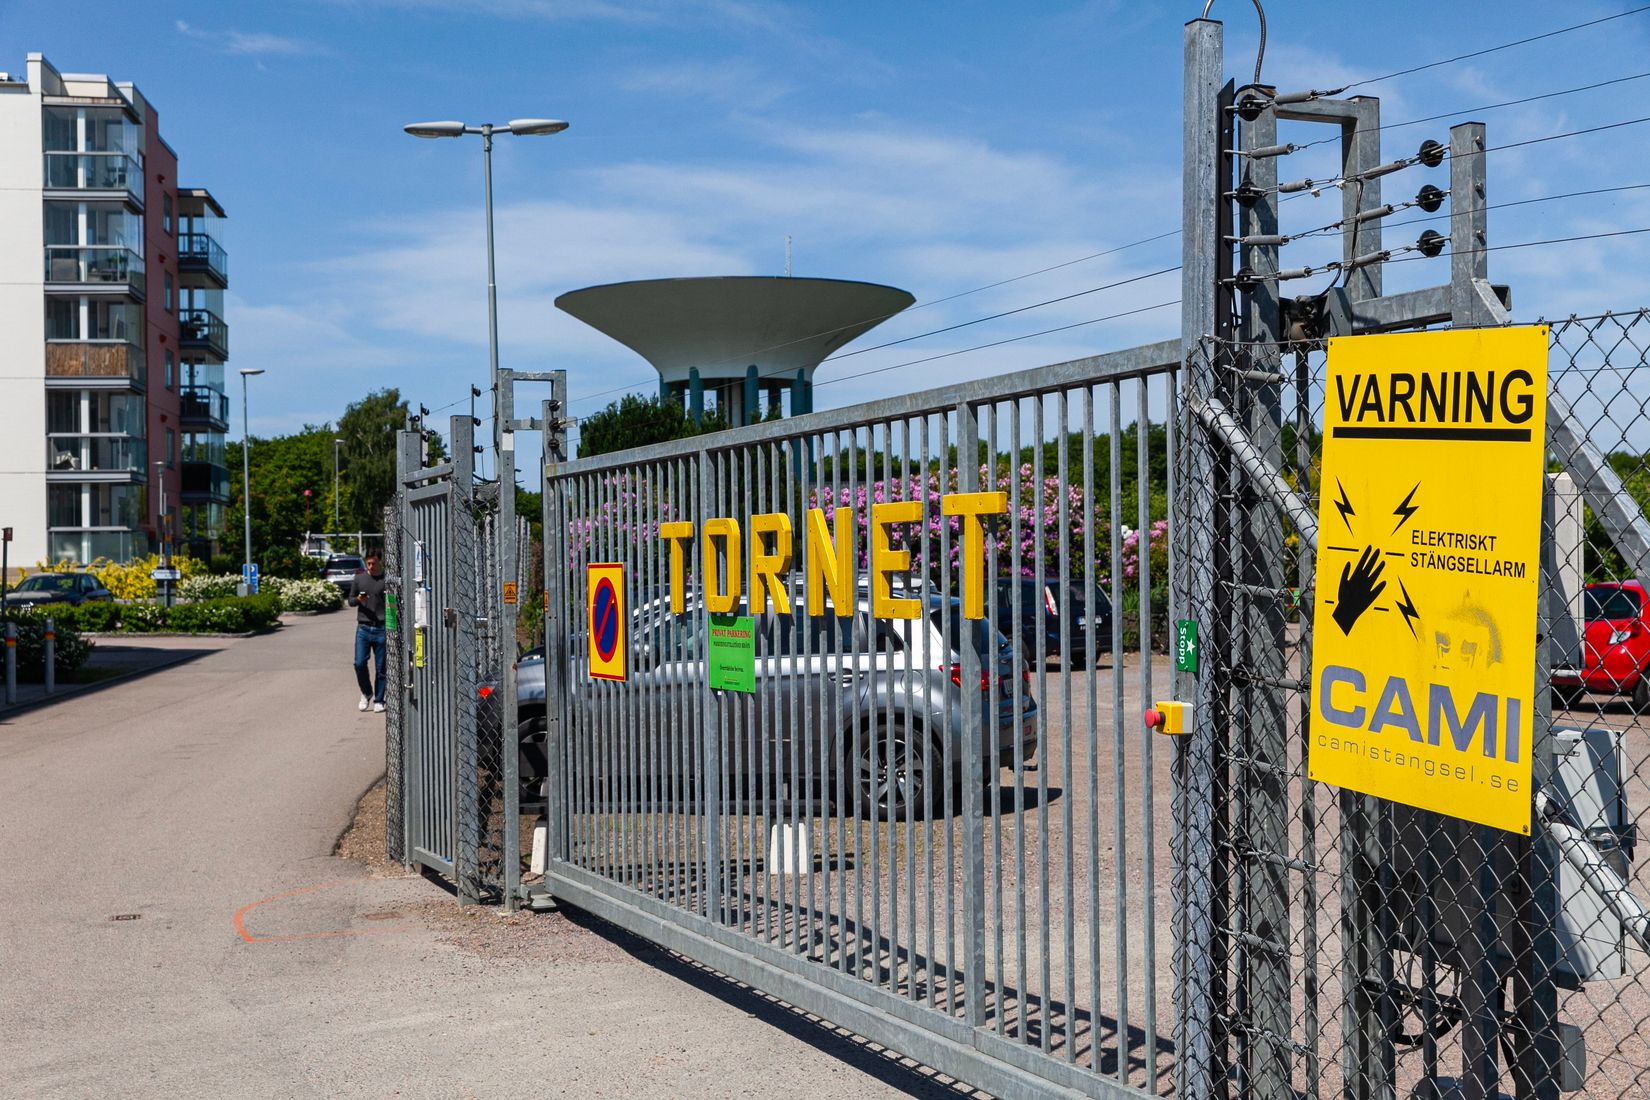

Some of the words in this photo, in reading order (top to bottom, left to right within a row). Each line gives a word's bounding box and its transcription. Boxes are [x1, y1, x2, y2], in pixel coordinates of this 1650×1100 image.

[1335, 369, 1534, 424] VARNING
[660, 491, 1008, 620] TORNET
[1411, 529, 1497, 552] ELEKTRISKT
[1410, 550, 1526, 579] STÄNGSELLARM
[711, 629, 726, 638] PRIVAT
[727, 629, 751, 639] PARKERING
[1178, 627, 1187, 664] Stopp
[1319, 664, 1521, 764] CAMI
[1317, 734, 1519, 793] camistangsel.se
